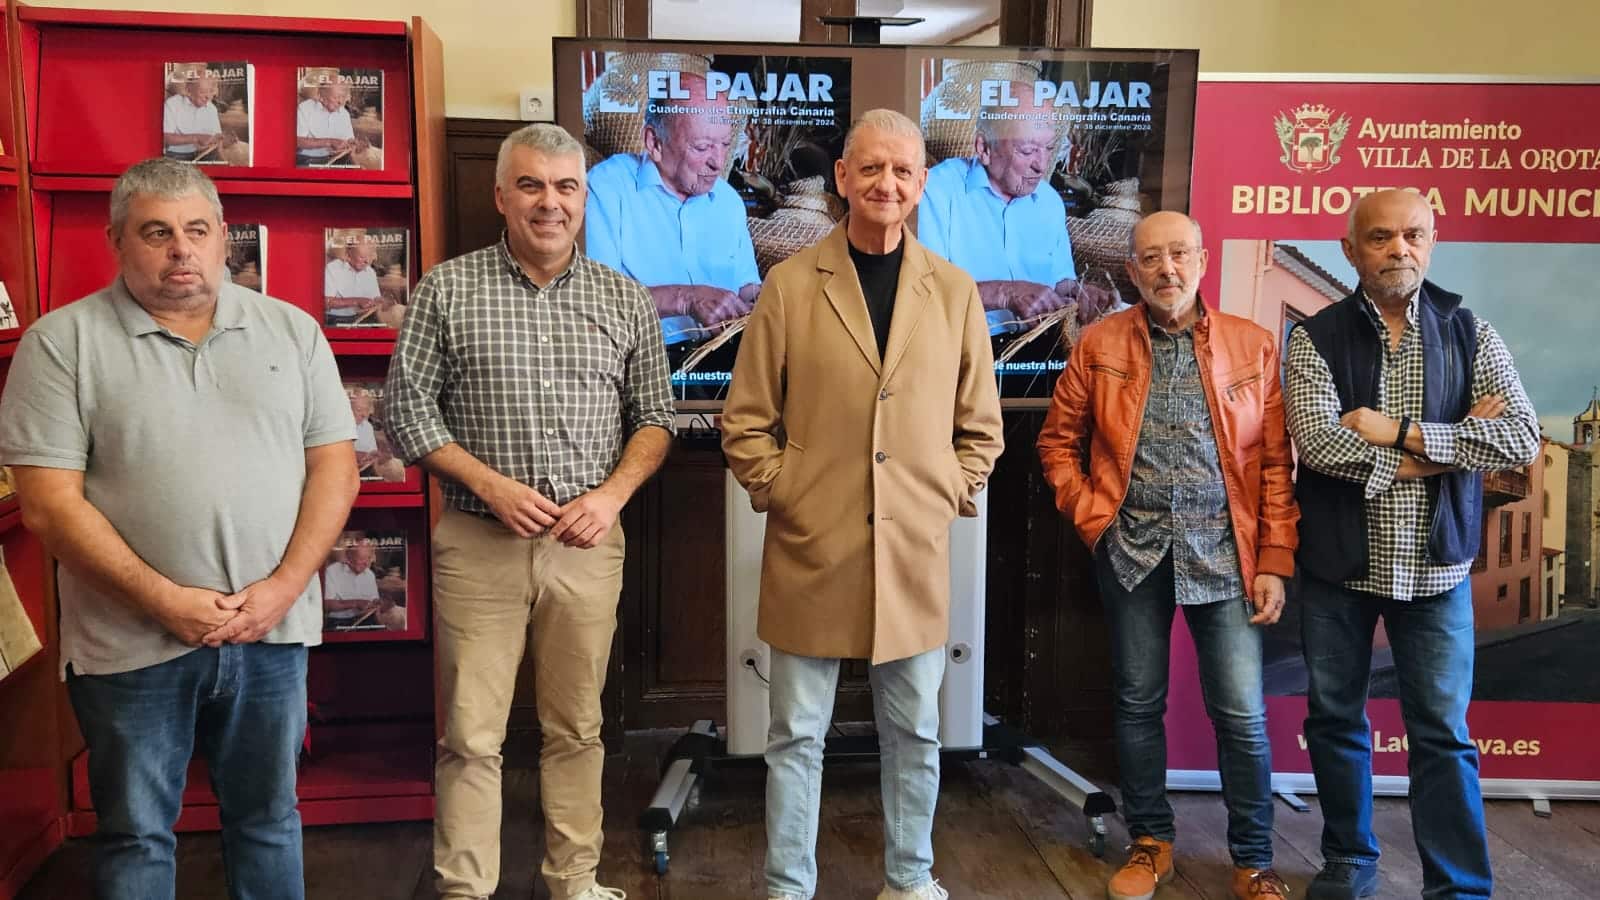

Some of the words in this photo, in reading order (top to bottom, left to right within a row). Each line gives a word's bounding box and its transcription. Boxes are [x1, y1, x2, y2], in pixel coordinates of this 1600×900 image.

[186, 70, 200, 79] EL
[205, 68, 245, 79] PAJAR
[319, 74, 333, 84] EL
[337, 74, 379, 85] PAJAR
[648, 70, 690, 99] EL
[706, 72, 834, 102] PAJAR
[980, 79, 1019, 107] EL
[1033, 80, 1152, 108] PAJAR
[648, 104, 705, 114] Cuaderno
[790, 106, 835, 117] Canaria
[980, 111, 1032, 120] Cuaderno
[1110, 112, 1151, 122] Canaria
[1357, 117, 1522, 143] Ayuntamiento
[1357, 147, 1433, 168] VILLA
[1440, 147, 1474, 169] DE
[1479, 148, 1512, 169] LA
[346, 235, 360, 244] EL
[364, 233, 402, 244] PAJAR
[1006, 360, 1046, 370] nuestra
[672, 369, 687, 380] de
[689, 370, 732, 380] nuestra
